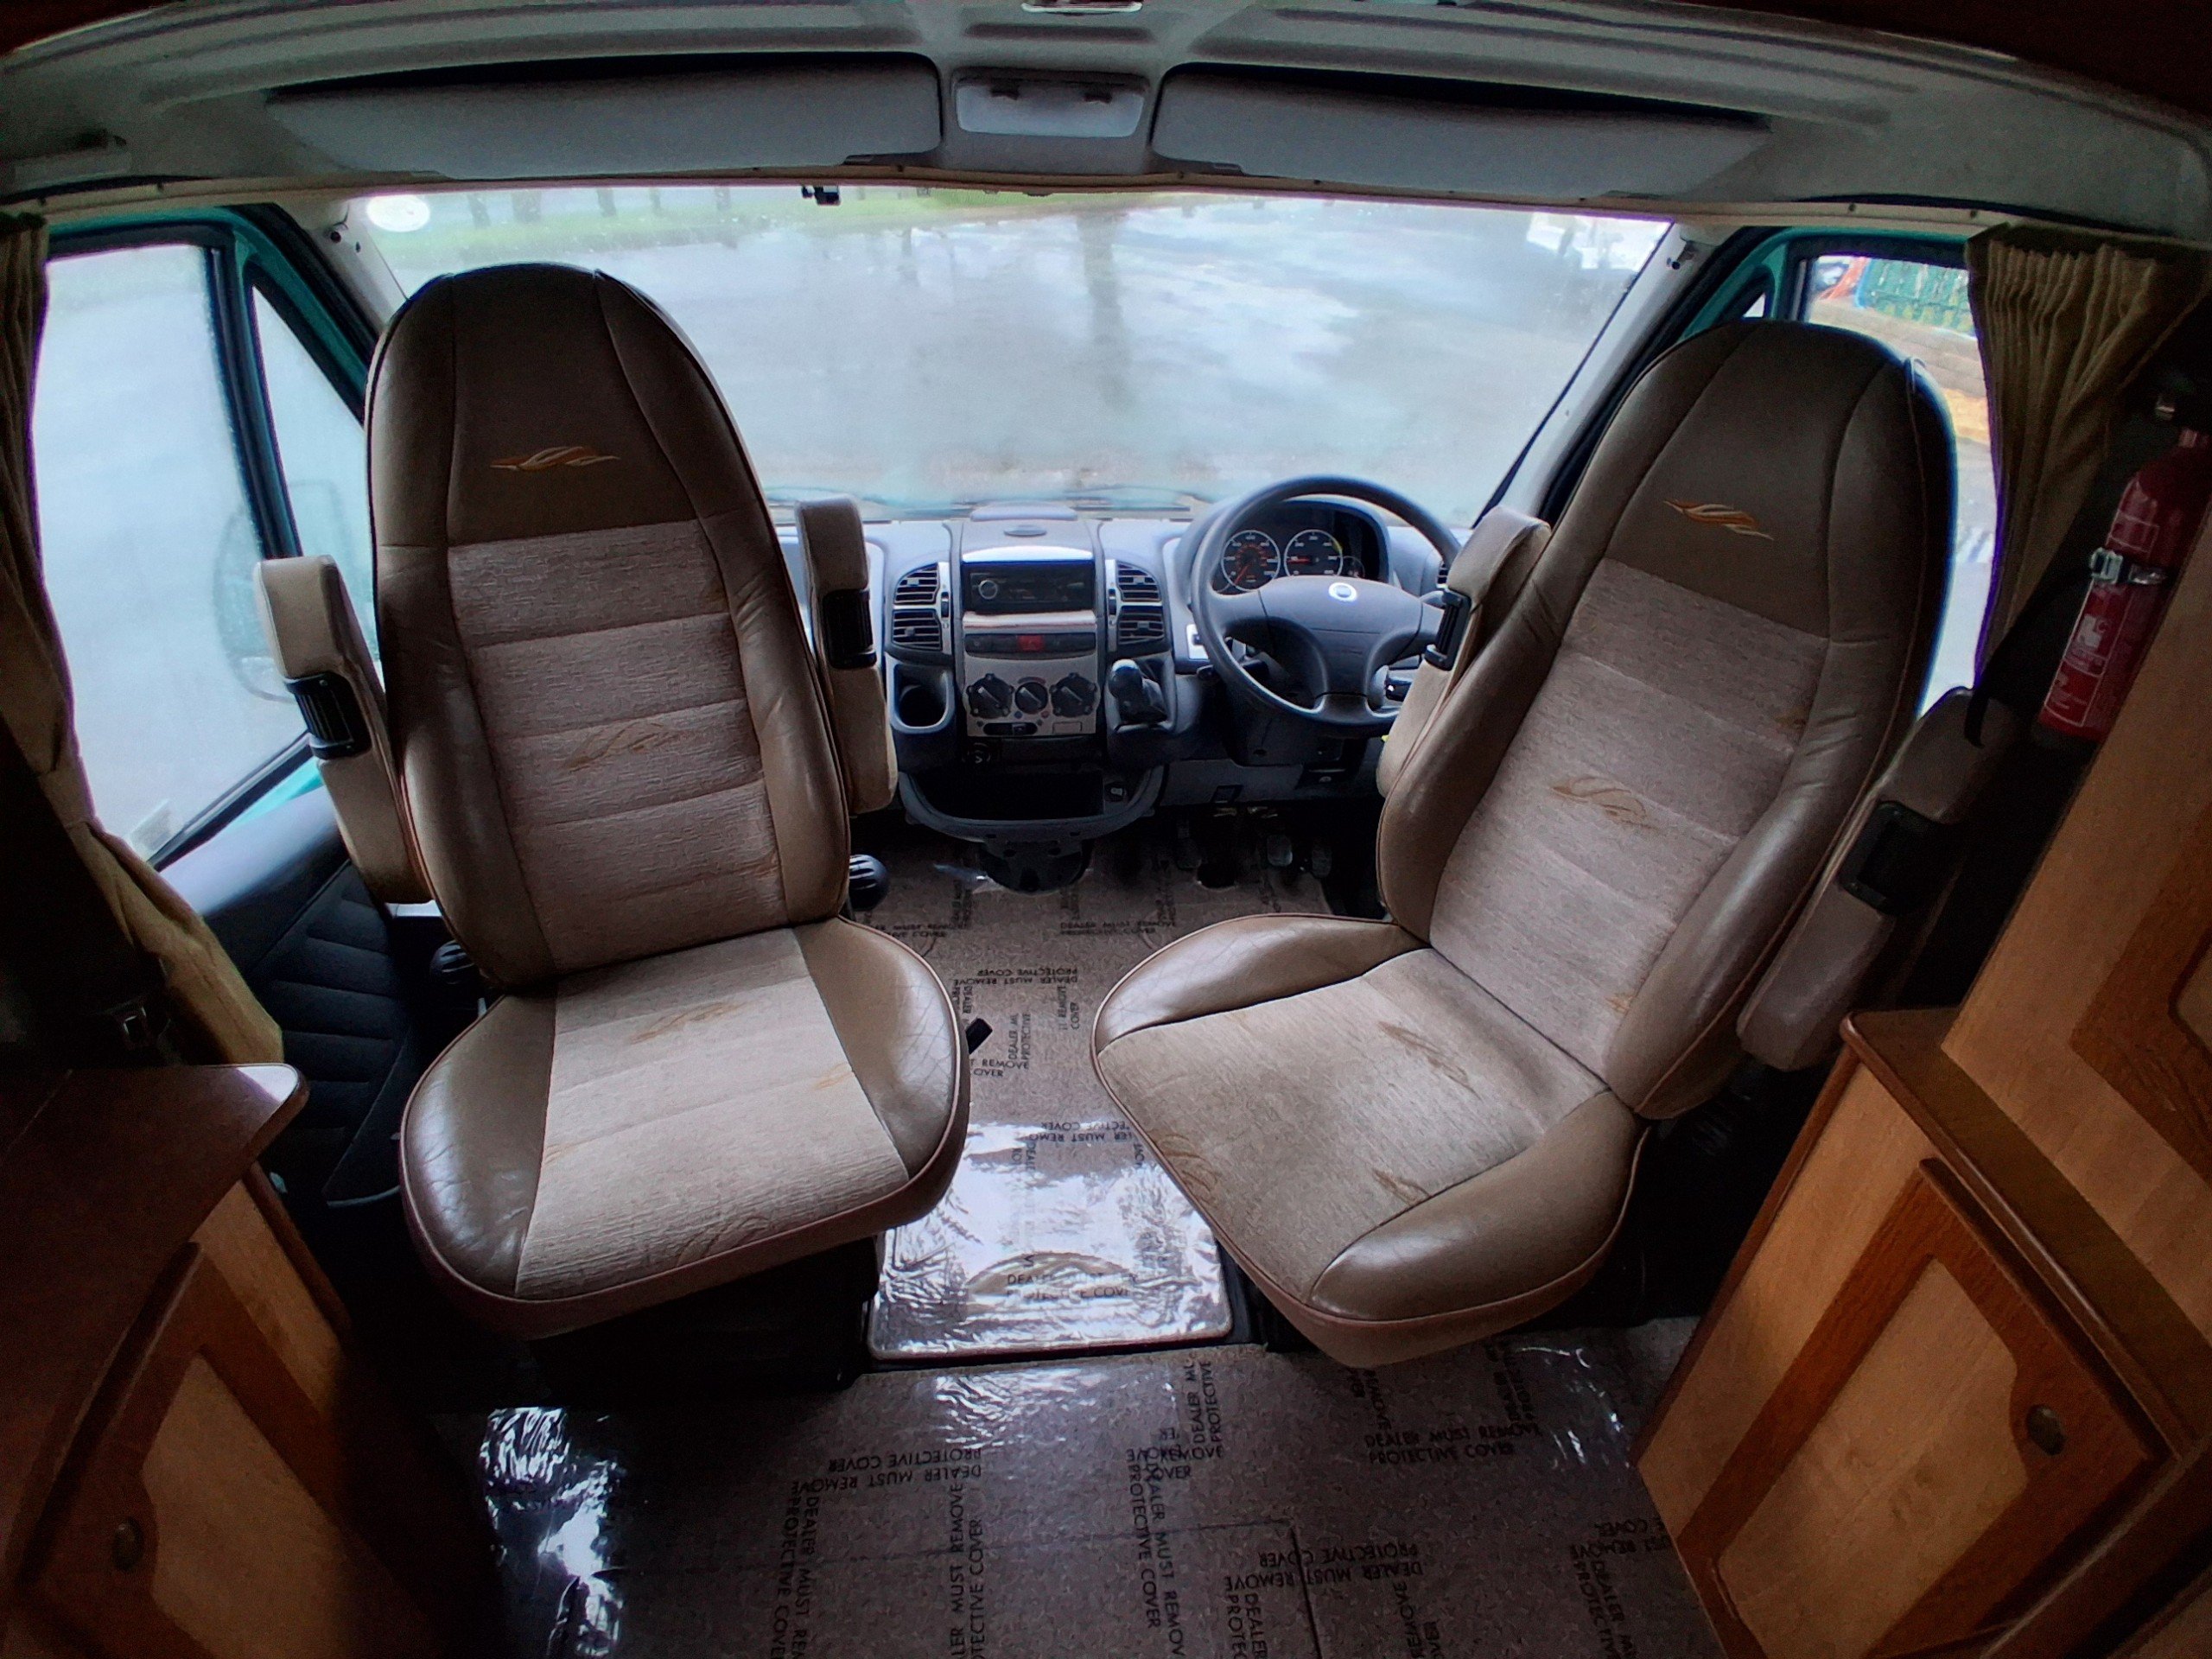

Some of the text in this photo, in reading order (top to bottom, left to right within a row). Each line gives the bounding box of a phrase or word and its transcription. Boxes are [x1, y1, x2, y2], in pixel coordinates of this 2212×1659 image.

[954, 976, 1078, 987] DEALER MUST REMOVE
[976, 967, 1078, 977] PROTECTIVE COVER
[972, 1068, 1004, 1077] OVER
[982, 1058, 1029, 1070] REMOVE
[1040, 1122, 1081, 1132] COVER
[1071, 1132, 1104, 1142] MUST
[1186, 1391, 1205, 1444] DEALER
[828, 1447, 982, 1473] PROTECTIVE COVER
[791, 1465, 982, 1494] DEALER MUST REMOVE
[950, 1482, 965, 1554] REMOVE
[968, 1518, 985, 1577] COVER
[1128, 1464, 1162, 1629] PROTECTIVE COVER
[1154, 1531, 1175, 1580] MUST
[950, 1565, 965, 1613] MUST
[1224, 1571, 1295, 1592] REMOVE
[1306, 1567, 1352, 1586] MUST
[795, 1567, 813, 1617] MUST
[771, 1605, 790, 1659] COVE
